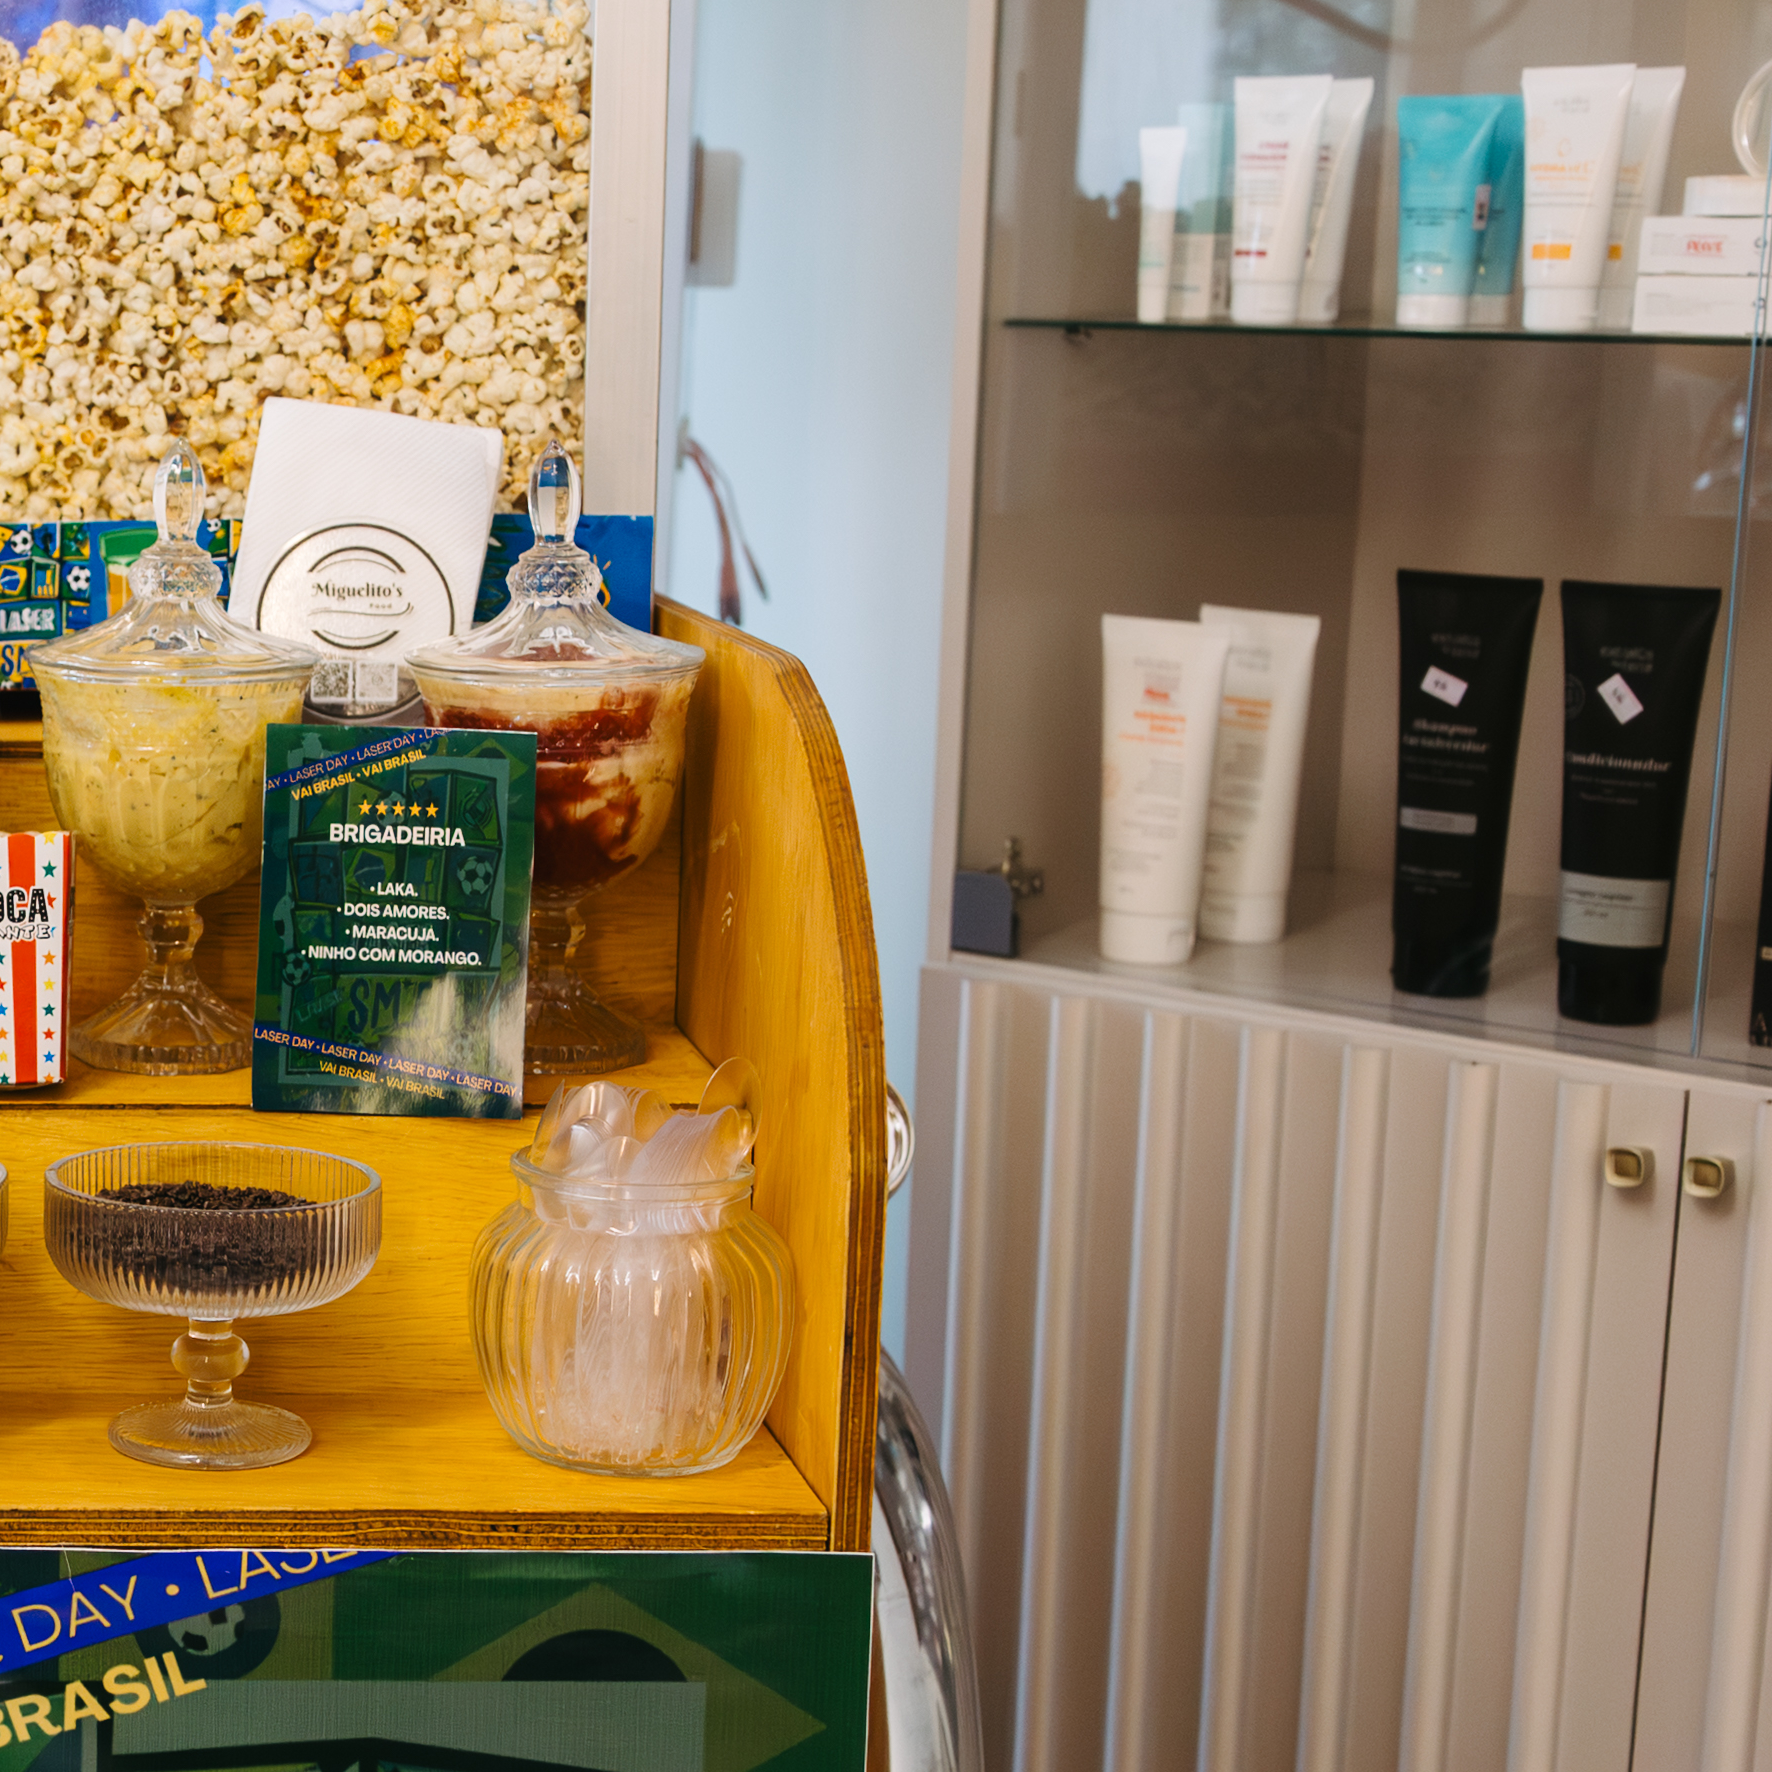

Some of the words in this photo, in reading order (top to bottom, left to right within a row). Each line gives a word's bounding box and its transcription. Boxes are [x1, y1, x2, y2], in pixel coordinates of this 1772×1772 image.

[311, 582, 403, 600] Miguelito's
[0, 607, 55, 634] LASER
[267, 777, 280, 790] AY
[290, 763, 324, 783] LASER
[326, 755, 349, 771] DAY
[356, 740, 392, 761] LASER
[393, 733, 416, 750] DAY
[291, 785, 313, 801] VAI
[313, 774, 355, 794] BRASIL
[362, 761, 383, 778] VAI
[384, 749, 427, 770] BRASIL
[329, 823, 466, 847] BRIGADEIRIA
[377, 883, 418, 897] LAKA.
[344, 903, 380, 917] DOIS
[383, 906, 450, 920] AMORES.
[308, 946, 356, 960] NINHO
[358, 948, 396, 963] COM
[398, 950, 482, 966] MORANGO.
[254, 1028, 290, 1046] LASER
[291, 1036, 315, 1050] DAY
[321, 1043, 357, 1060] LASER
[359, 1051, 382, 1065] DAY
[389, 1058, 424, 1075] LASER
[426, 1066, 450, 1081] DAY
[456, 1074, 492, 1091] LASER
[493, 1083, 518, 1097] DAY
[319, 1060, 337, 1075] VAI
[338, 1065, 378, 1084] BRASIL
[386, 1076, 404, 1090] VAI
[406, 1080, 445, 1099] BRASIL
[11, 1574, 138, 1653] DAY
